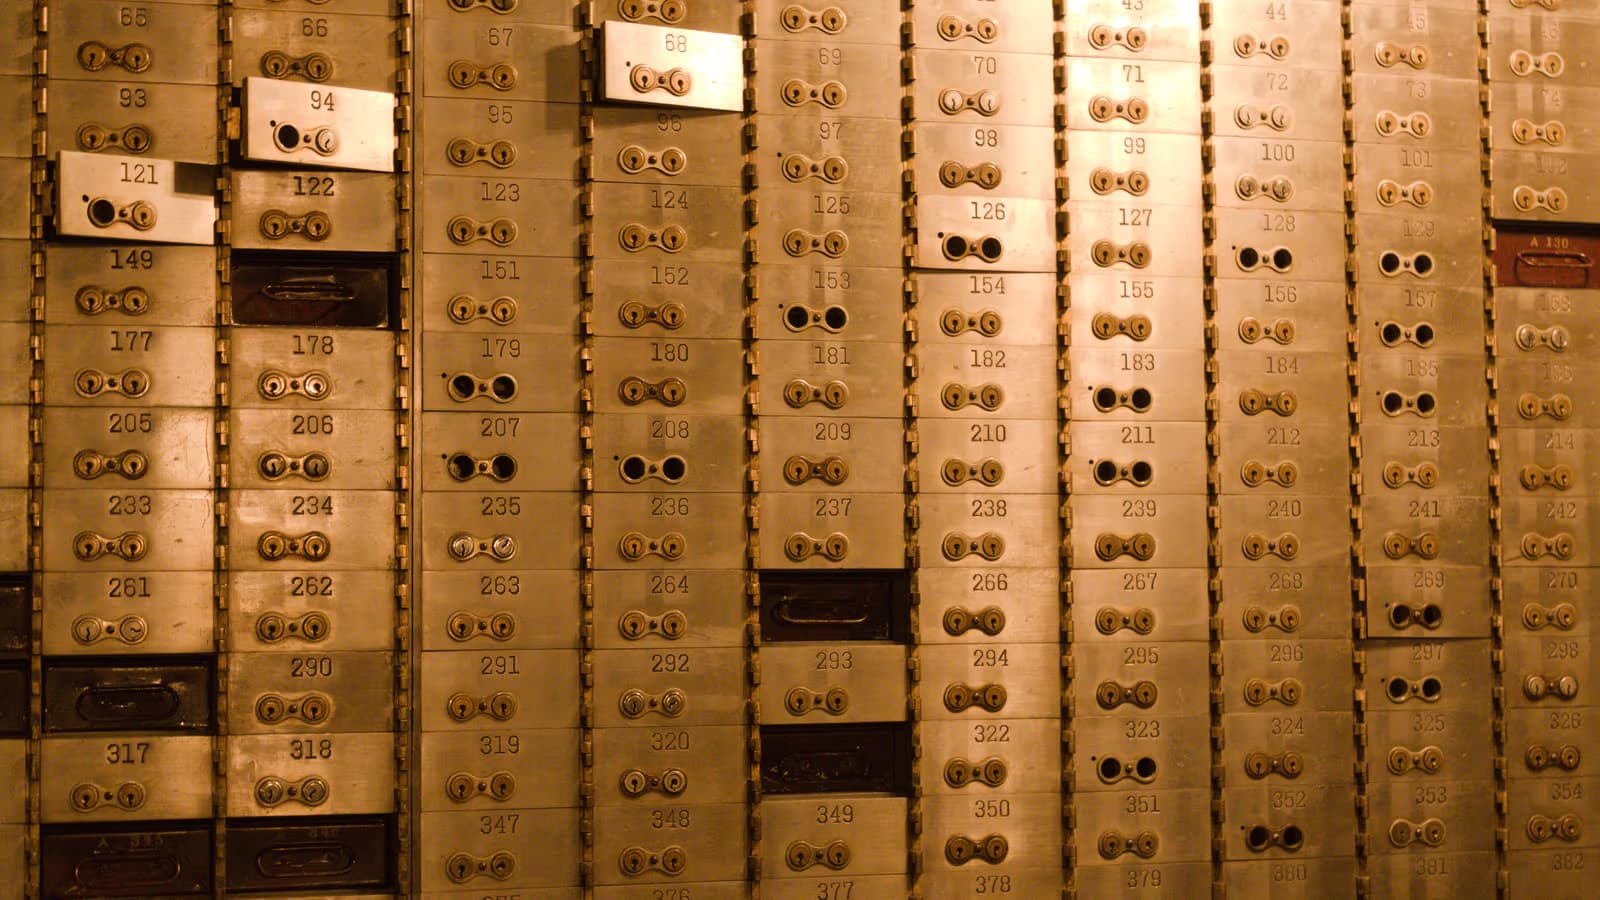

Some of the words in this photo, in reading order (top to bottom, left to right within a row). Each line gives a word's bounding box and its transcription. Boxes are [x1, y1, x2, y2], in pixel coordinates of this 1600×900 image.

[1122, 0, 1143, 10] 43
[1265, 3, 1286, 20] 44
[120, 7, 147, 27] 65
[302, 18, 328, 37] 66
[489, 28, 512, 46] 67
[665, 34, 687, 52] 68
[819, 48, 841, 65] 69
[974, 56, 996, 74] 70
[1123, 64, 1144, 83] 71
[1267, 72, 1288, 91] 72
[120, 88, 147, 108] 93
[1406, 80, 1426, 98] 73
[311, 90, 334, 111] 94
[488, 105, 512, 124] 95
[658, 113, 682, 132] 96
[820, 122, 843, 140] 97
[975, 129, 997, 147] 98
[1124, 137, 1145, 154] 99
[1262, 144, 1294, 161] 100
[1401, 150, 1432, 168] 101
[121, 162, 158, 184] 121
[293, 176, 334, 196] 122
[481, 182, 519, 202] 123
[651, 190, 688, 209] 124
[814, 195, 849, 214] 125
[971, 201, 1005, 220] 126
[1119, 208, 1152, 226] 127
[1262, 214, 1295, 232] 128
[1403, 219, 1434, 238] 129
[1530, 235, 1539, 248] A
[1545, 236, 1569, 249] 130
[110, 249, 152, 269] 149
[482, 260, 520, 280] 151
[652, 266, 688, 285] 152
[815, 270, 850, 289] 153
[970, 276, 1005, 294] 154
[1120, 280, 1153, 298] 155
[1265, 285, 1296, 303] 156
[111, 331, 152, 351] 177
[293, 335, 333, 355] 178
[482, 338, 520, 358] 179
[651, 343, 688, 362] 180
[814, 346, 850, 365] 181
[971, 349, 1005, 368] 182
[1121, 353, 1154, 371] 183
[1266, 356, 1298, 374] 184
[1407, 359, 1438, 377] 185
[110, 413, 152, 433] 205
[293, 415, 333, 435] 206
[481, 418, 519, 437] 207
[652, 420, 689, 438] 208
[816, 423, 851, 440] 209
[971, 424, 1006, 442] 210
[1122, 426, 1155, 444] 211
[1267, 427, 1300, 445] 212
[1408, 430, 1440, 447] 213
[1543, 432, 1575, 450] 214
[109, 495, 151, 515] 233
[292, 496, 333, 515] 234
[482, 497, 520, 515] 235
[652, 497, 688, 515] 236
[816, 498, 851, 517] 237
[972, 500, 1007, 517] 238
[1123, 500, 1156, 517] 239
[1269, 499, 1301, 517] 240
[1409, 501, 1441, 518] 241
[1546, 501, 1576, 519] 242
[109, 577, 150, 597] 261
[291, 576, 332, 596] 262
[481, 576, 519, 595] 263
[652, 576, 688, 594] 264
[973, 573, 1007, 591] 266
[1124, 572, 1157, 590] 267
[1269, 572, 1303, 589] 268
[1414, 570, 1445, 588] 269
[1547, 571, 1578, 589] 270
[816, 649, 852, 669] 293
[973, 649, 1008, 667] 294
[1124, 647, 1158, 664] 295
[1270, 645, 1304, 663] 296
[1413, 643, 1443, 661] 297
[1549, 641, 1580, 660] 298
[291, 657, 332, 677] 290
[481, 656, 520, 675] 291
[652, 654, 689, 672] 292
[1126, 720, 1160, 738] 323
[1272, 717, 1304, 736] 324
[1412, 713, 1446, 732] 325
[1549, 712, 1583, 730] 326
[652, 732, 689, 750] 320
[974, 725, 1009, 742] 322
[107, 743, 150, 764] 317
[290, 739, 331, 760] 318
[480, 735, 520, 754] 319
[1272, 790, 1306, 809] 352
[1416, 786, 1447, 805] 353
[1551, 782, 1583, 800] 354
[975, 800, 1010, 818] 350
[1126, 794, 1160, 813] 351
[652, 809, 689, 829] 348
[817, 804, 853, 824] 349
[480, 814, 519, 834] 347
[1415, 858, 1448, 876] 381
[1552, 853, 1584, 871] 382
[1128, 869, 1161, 888] 379
[1273, 864, 1307, 883] 380
[817, 881, 854, 900] 377
[976, 875, 1011, 893] 378
